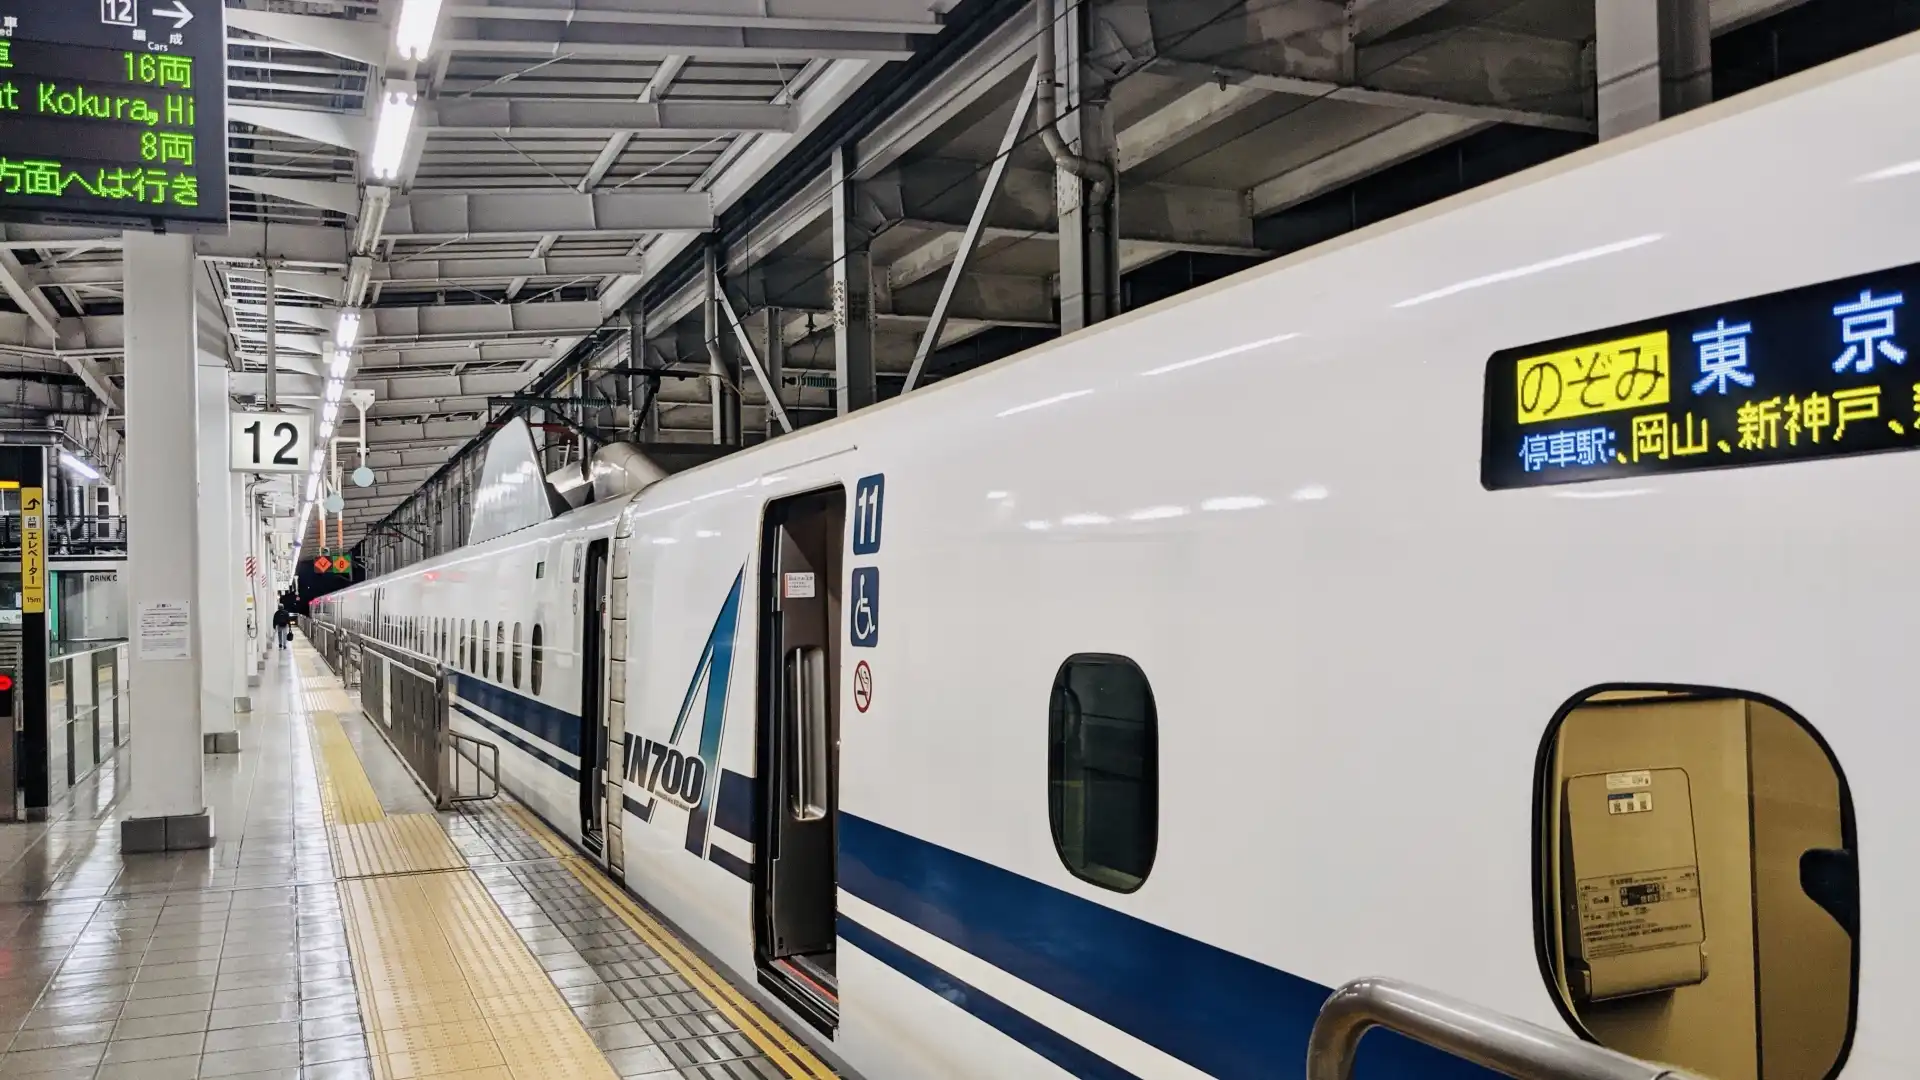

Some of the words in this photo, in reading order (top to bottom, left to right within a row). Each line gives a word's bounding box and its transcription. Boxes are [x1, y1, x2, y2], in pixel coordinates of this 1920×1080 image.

[106, 0, 132, 22] 12
[147, 41, 168, 52] Cars
[124, 52, 193, 88] 16両
[141, 132, 194, 166] 8両
[0, 157, 198, 206] 方面へは行き
[1520, 346, 1665, 416] のぞみ
[1691, 289, 1908, 395] 東京
[244, 420, 299, 465] 12
[858, 484, 879, 545] 11
[28, 531, 39, 585] エレベーター
[89, 574, 111, 582] DRINK
[26, 596, 42, 604] 15m
